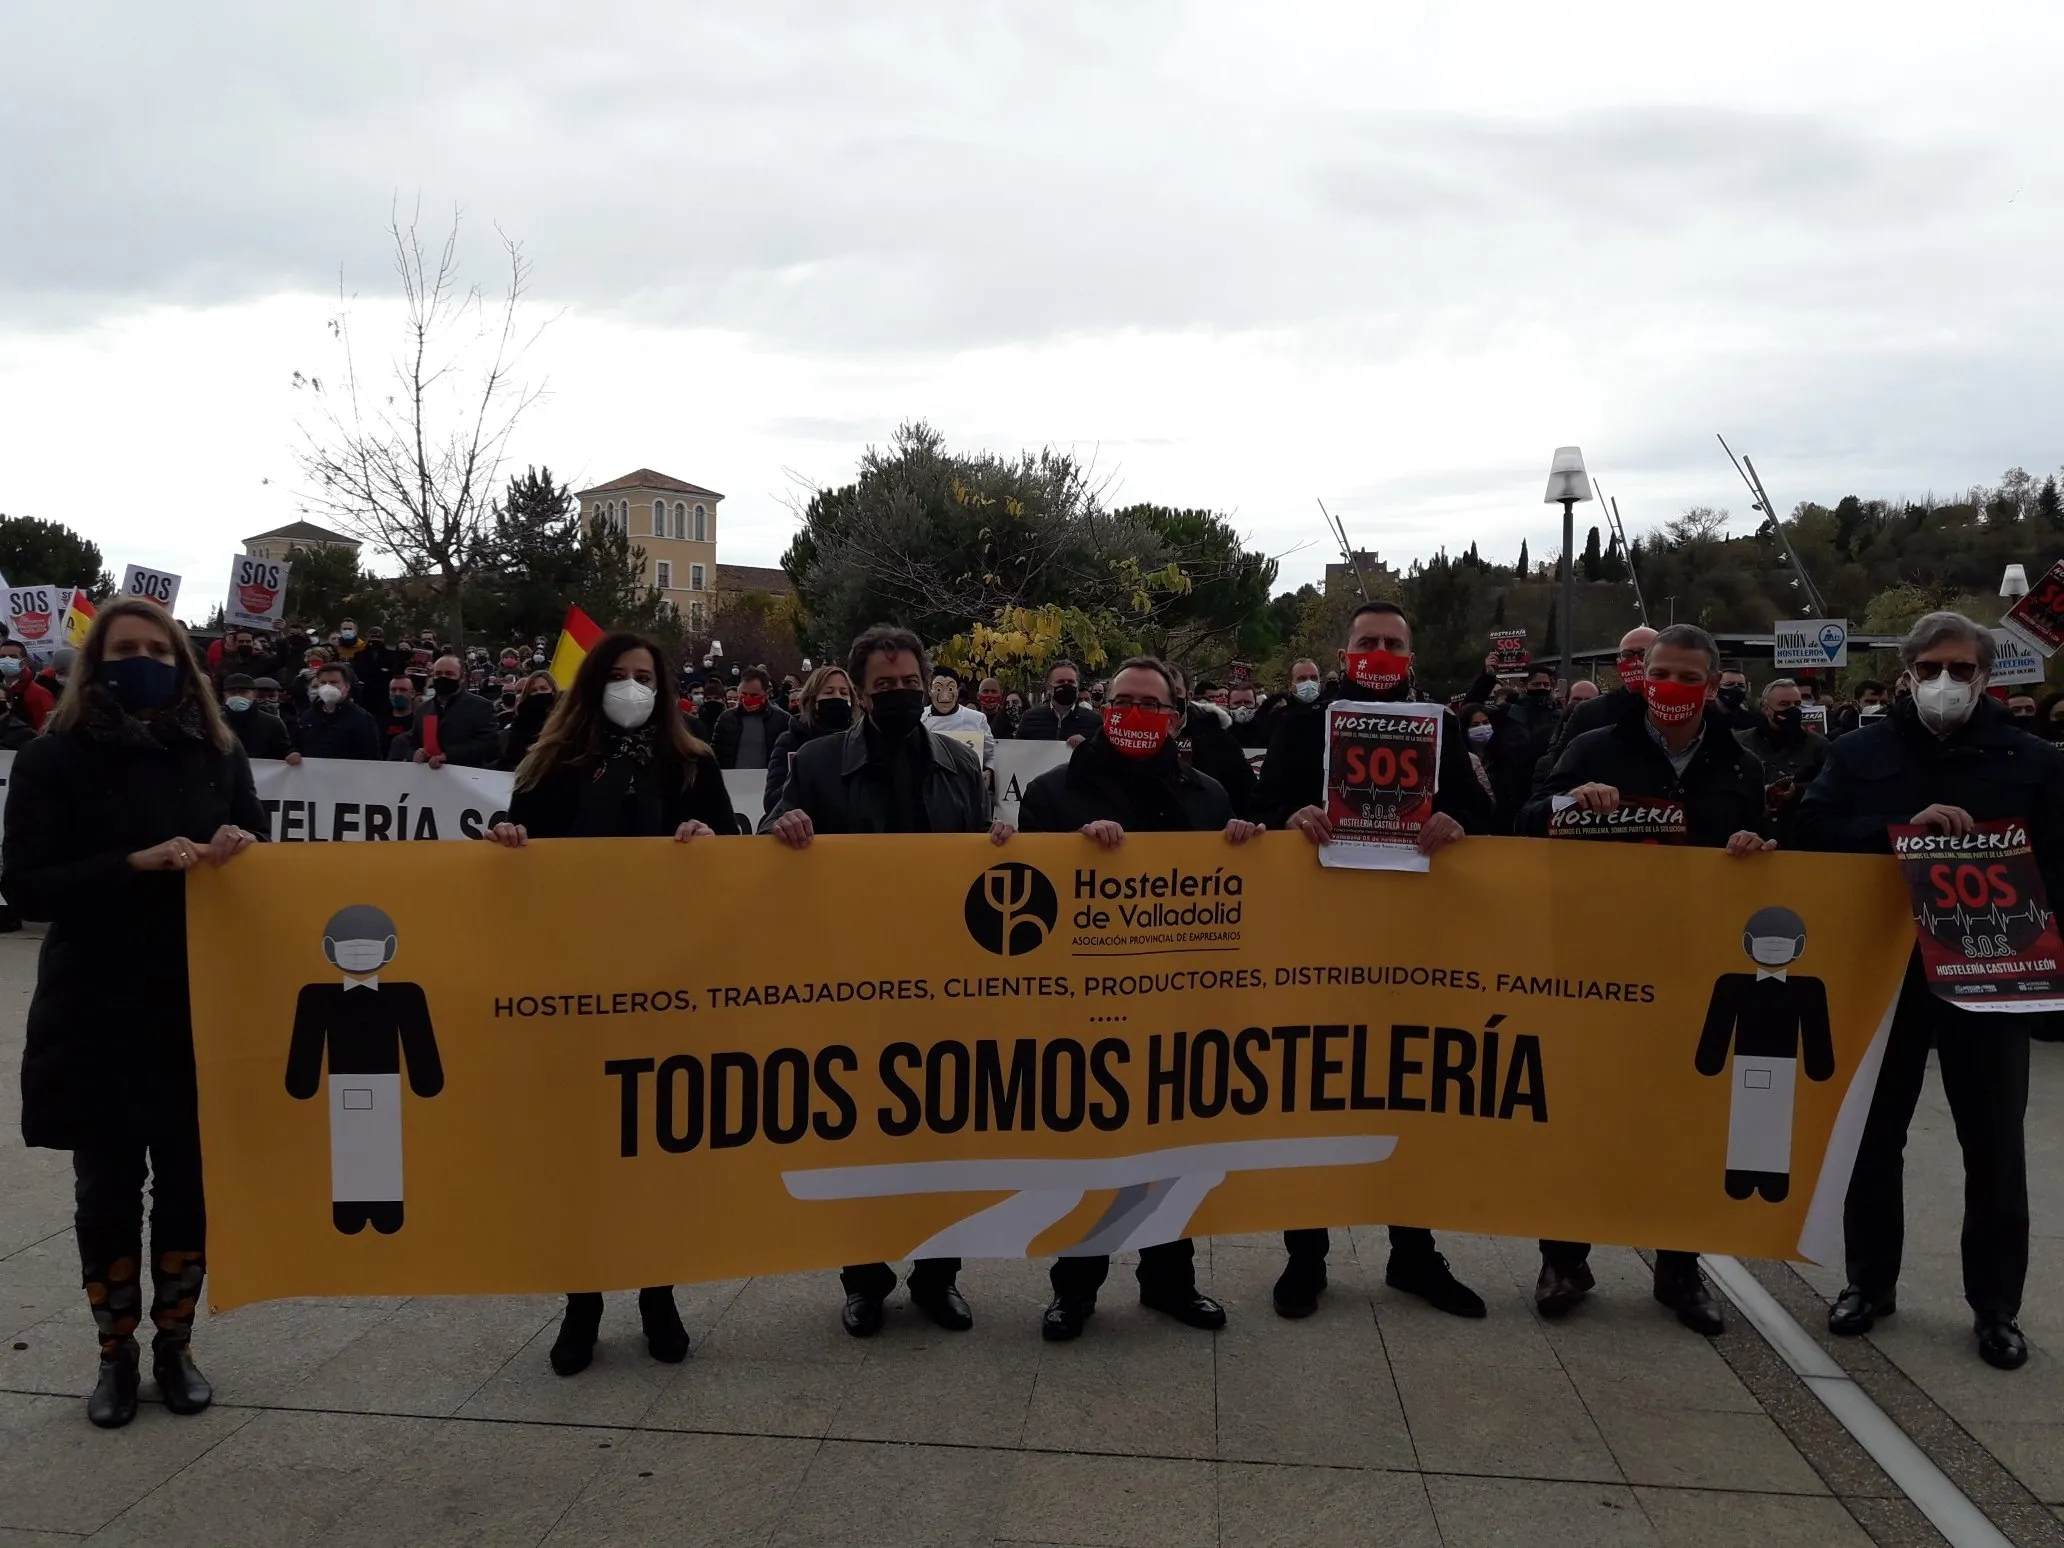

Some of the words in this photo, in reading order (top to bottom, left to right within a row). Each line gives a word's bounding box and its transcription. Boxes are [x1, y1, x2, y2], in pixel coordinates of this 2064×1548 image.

[132, 571, 171, 600] SOS
[241, 561, 279, 589] SOS
[10, 590, 49, 615] SOS
[1496, 639, 1521, 651] SOS
[1777, 630, 1806, 649] UNIÓN
[1995, 640, 2018, 660] NIÓN
[2021, 649, 2032, 657] de
[1777, 648, 1824, 657] HOSTELEROS
[1995, 657, 2036, 668] TELEROS
[1335, 715, 1435, 735] HOSTELERÍA
[1346, 745, 1419, 788] SOS
[262, 793, 439, 842] TELERÍA
[1362, 803, 1400, 820] S.O.S.
[1551, 805, 1684, 827] HOSTELERÍA
[1895, 824, 2027, 852] HOSTELERÍA
[1074, 867, 1243, 899] Hostelería
[1929, 863, 2018, 909] SOS
[1073, 904, 1110, 929] de
[1118, 901, 1242, 928] Valladolid
[1072, 934, 1127, 946] ASOCIACIÓN
[1129, 933, 1174, 945] PROVINCIAL
[1176, 932, 1186, 943] DE
[1188, 931, 1241, 942] EMPRESARIOS
[1962, 933, 2016, 959] S.O.S.
[1936, 962, 1986, 976] HOSTELERÍA
[1986, 961, 2025, 974] CASTILLA
[2025, 960, 2032, 971] Y
[2033, 957, 2057, 971] LEÓN
[494, 989, 698, 1018] HOSTELEROS,
[706, 979, 935, 1008] TRABAJADORES,
[944, 976, 1075, 998] CLIENTES,
[1084, 969, 1267, 996] PRODUCTORES,
[1275, 966, 1487, 993] DISTRIBUIDORES,
[1496, 974, 1655, 1003] FAMILIARES
[605, 1044, 858, 1158] TODOS
[877, 1037, 1129, 1136] SOMOS
[1148, 1014, 1549, 1123] HOSTELERÍA
